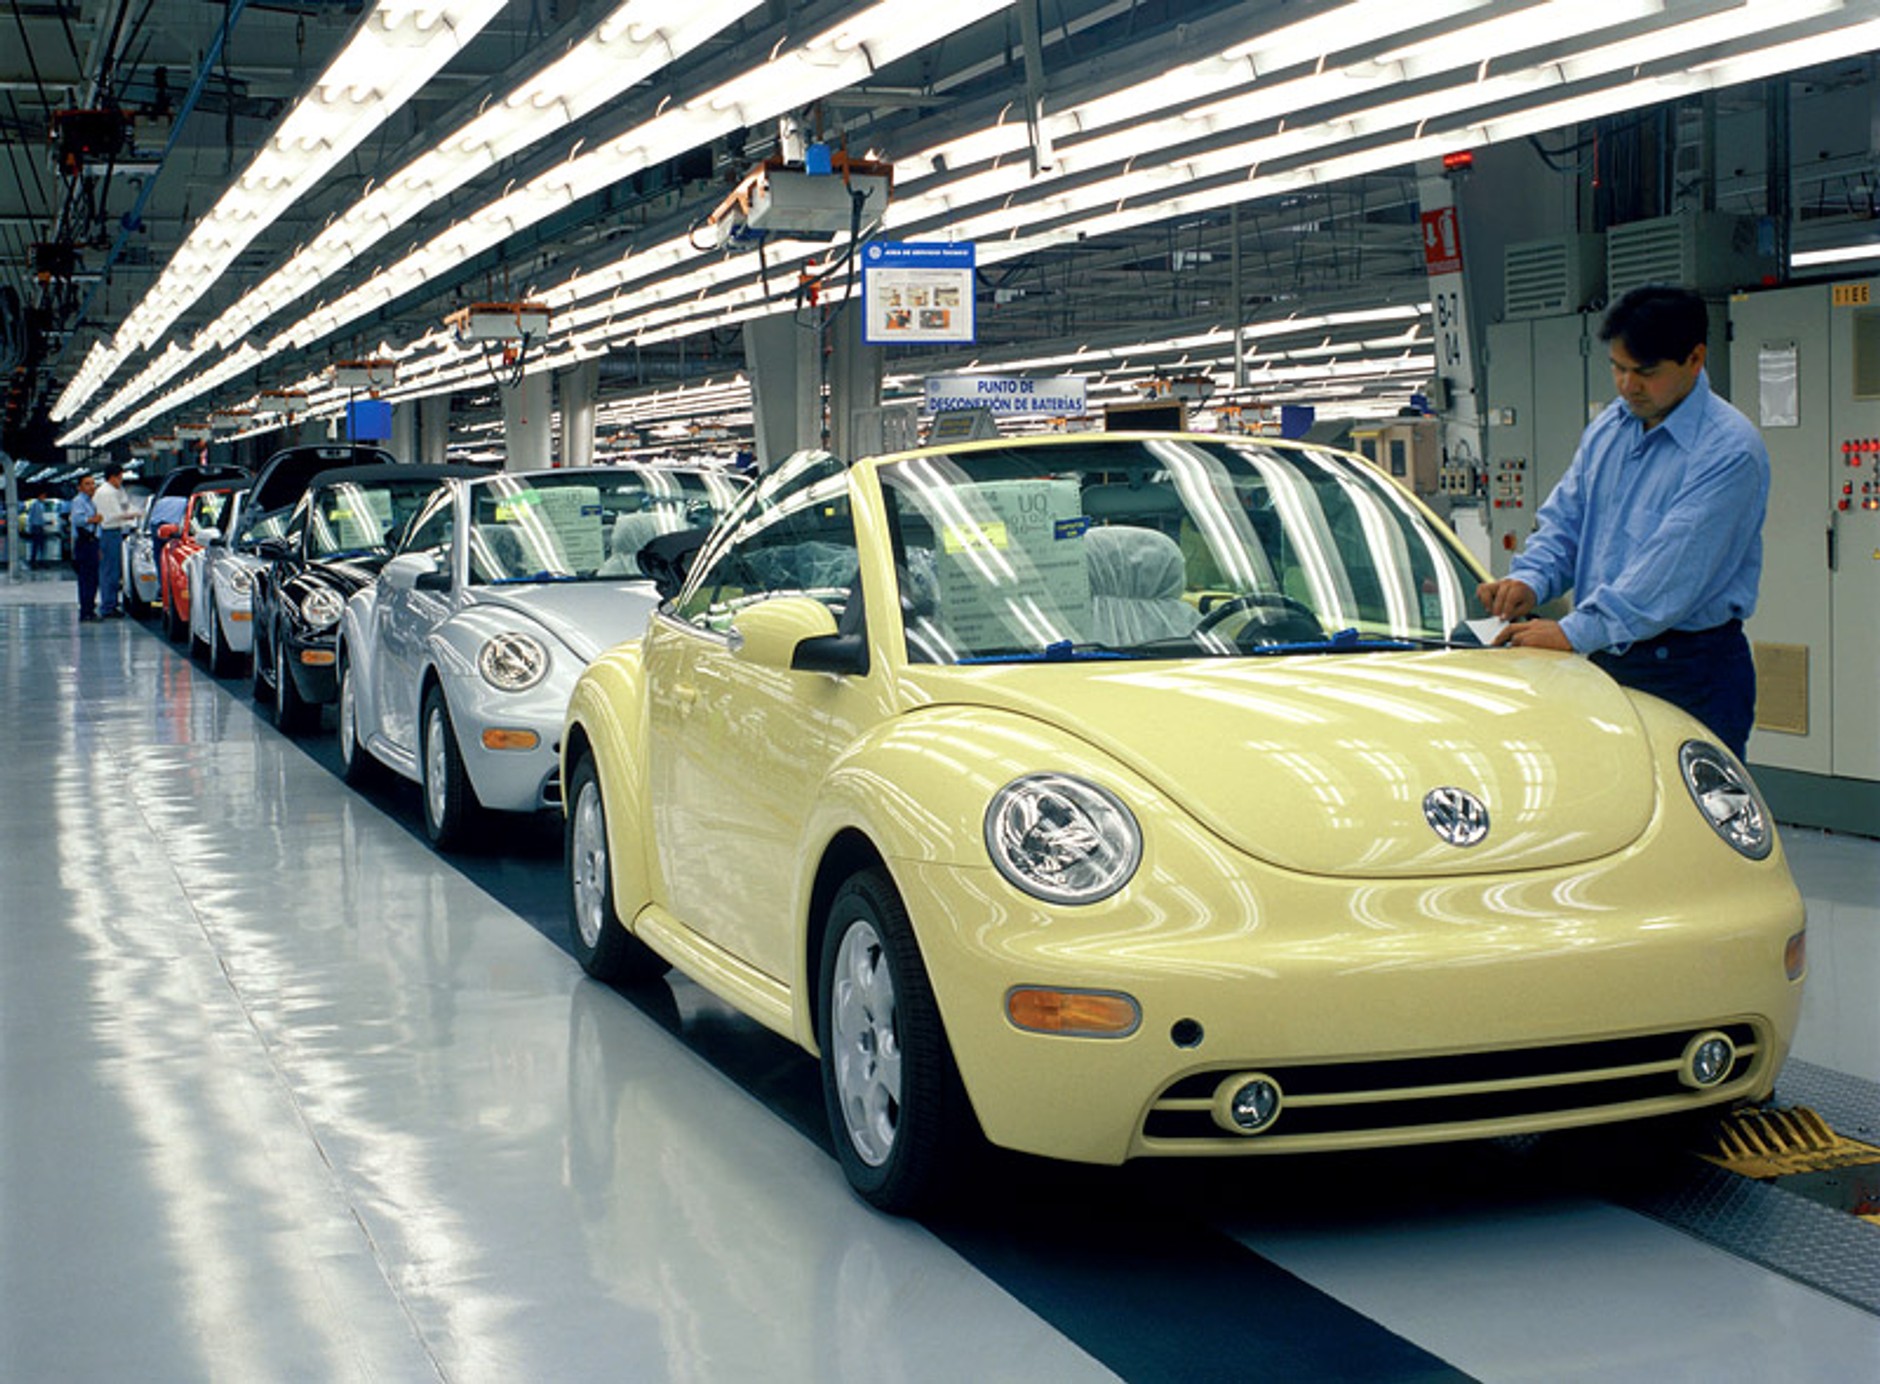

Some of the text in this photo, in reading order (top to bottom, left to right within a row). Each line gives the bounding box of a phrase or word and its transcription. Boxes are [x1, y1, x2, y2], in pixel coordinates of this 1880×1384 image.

[977, 380, 1034, 393] PUNTO DE
[930, 395, 1082, 411] DESCONEXIÓN DE BATERÍAS
